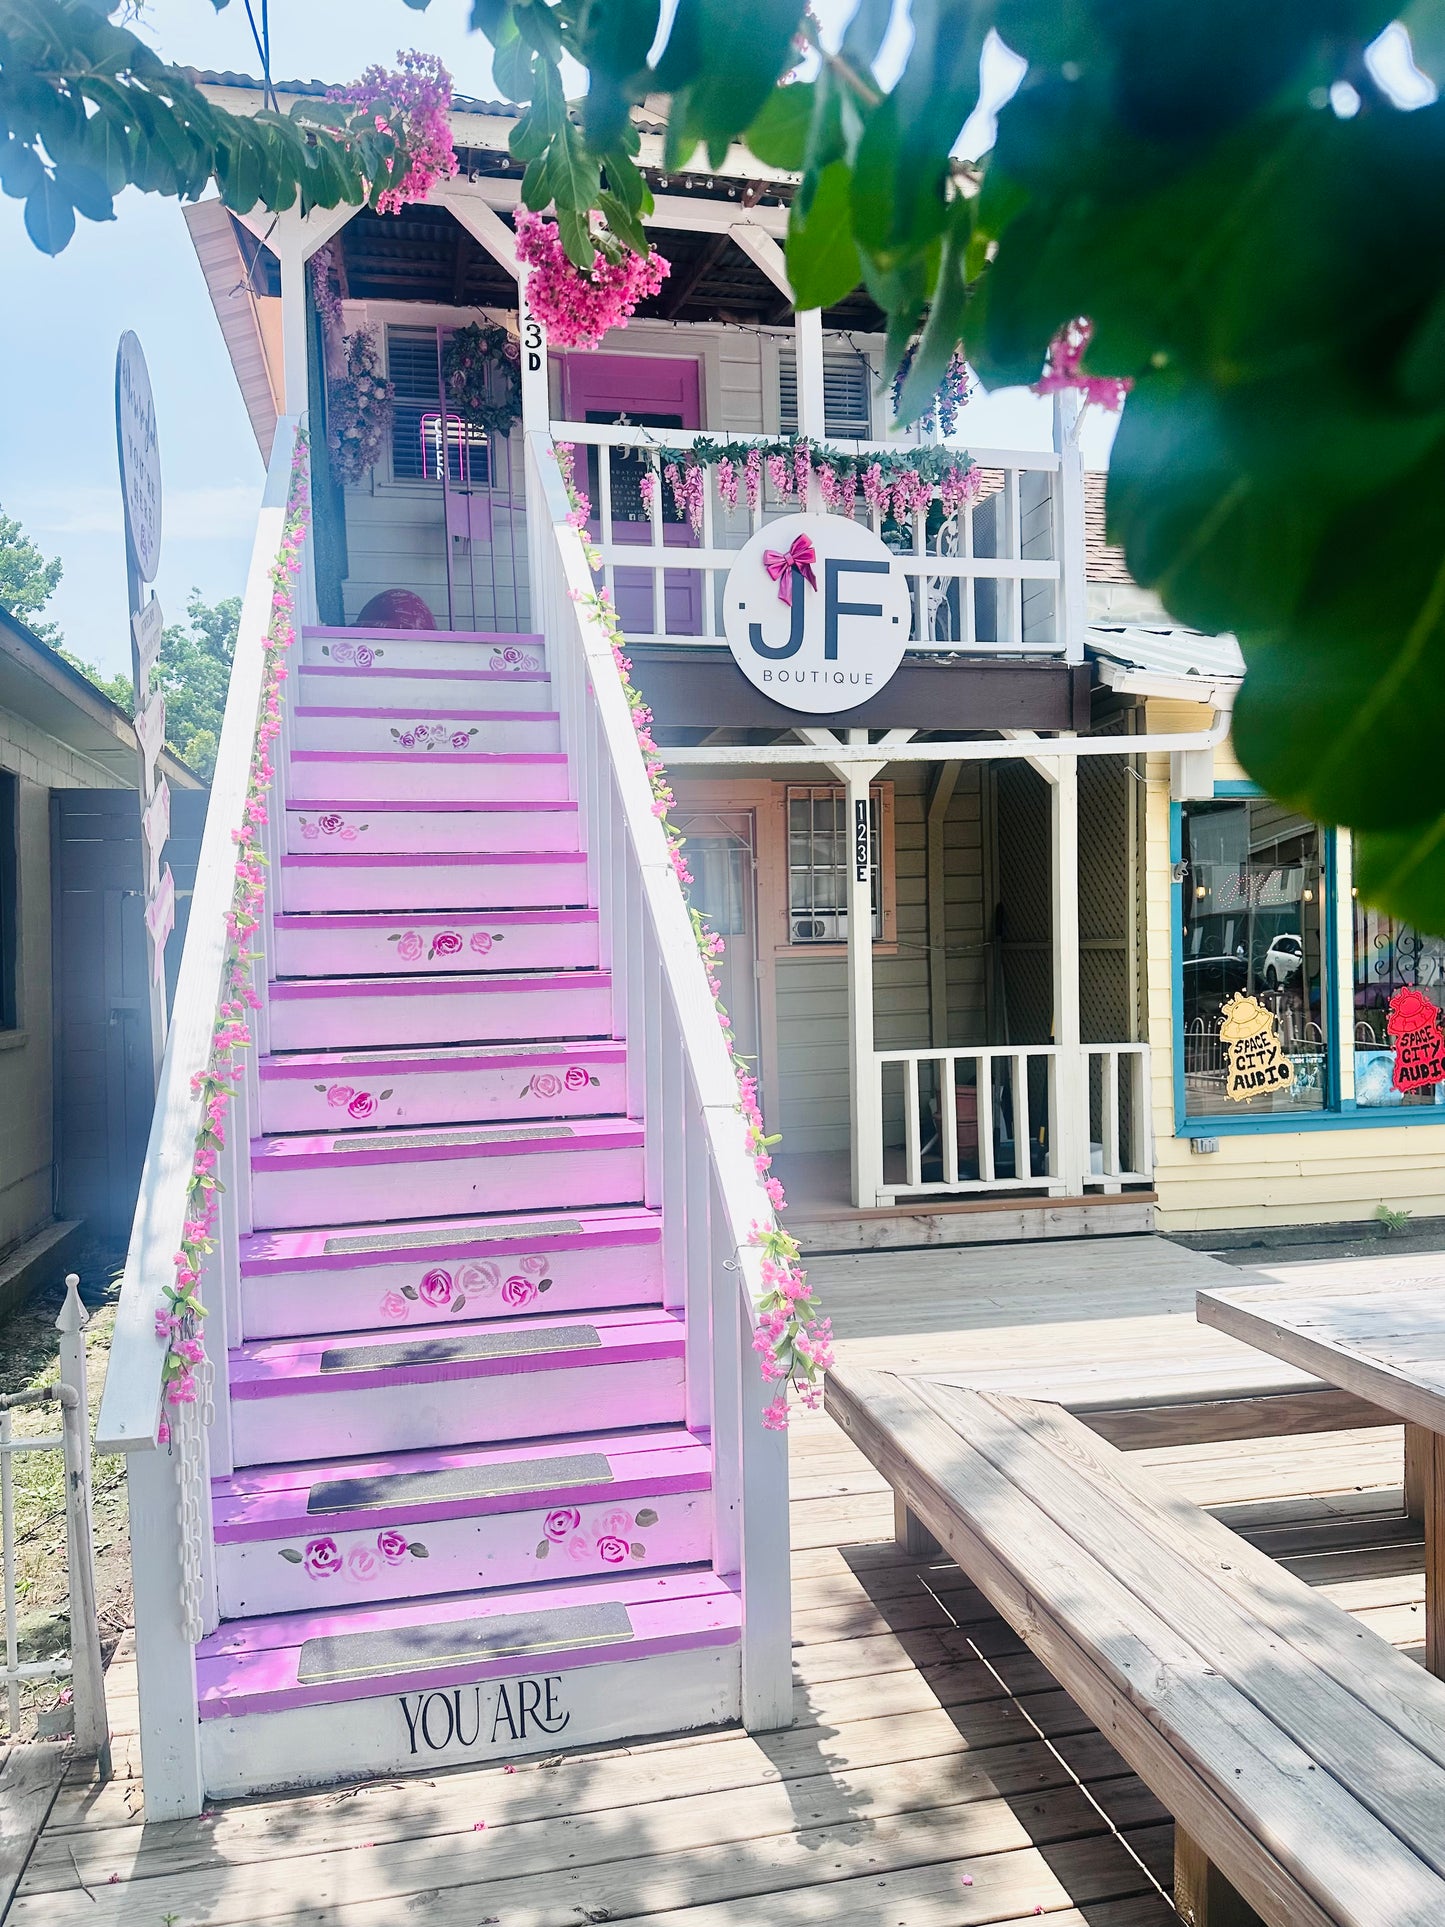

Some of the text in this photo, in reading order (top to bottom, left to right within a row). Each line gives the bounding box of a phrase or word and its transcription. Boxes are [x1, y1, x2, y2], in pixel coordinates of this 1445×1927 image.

[748, 558, 890, 660] JF
[763, 669, 873, 685] BOUTIQUE
[1234, 1031, 1271, 1054] SPACE
[1400, 1025, 1435, 1047] SPACE
[1236, 1046, 1277, 1071] CITY
[1402, 1040, 1440, 1063] CITY
[1233, 1063, 1290, 1091] AUDIO
[399, 1676, 570, 1754] YOU ARE
